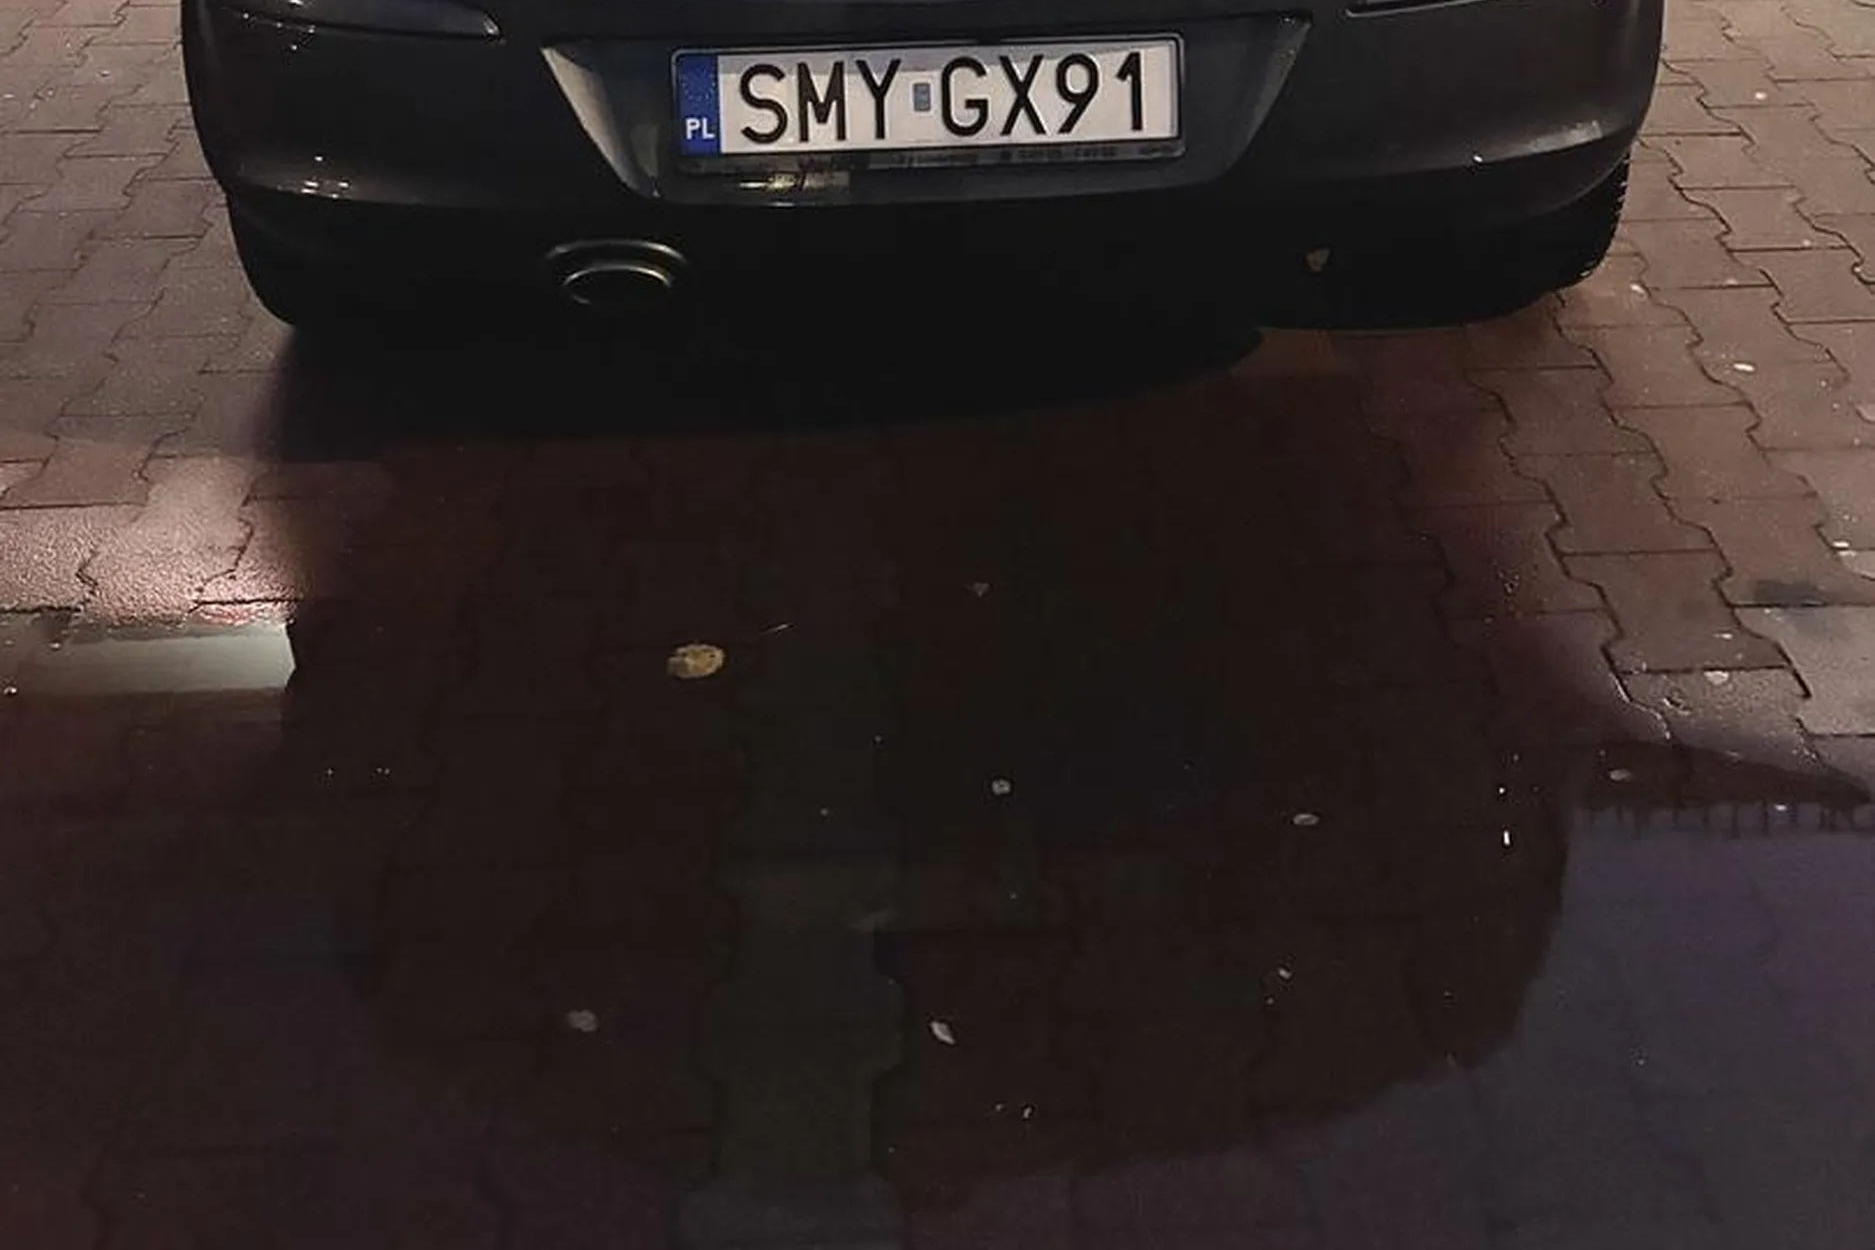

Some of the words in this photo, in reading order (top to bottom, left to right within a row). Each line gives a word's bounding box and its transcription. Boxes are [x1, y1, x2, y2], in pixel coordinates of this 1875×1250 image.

[686, 118, 715, 139] PL
[738, 58, 902, 145] SMY
[941, 51, 1144, 138] GX91
